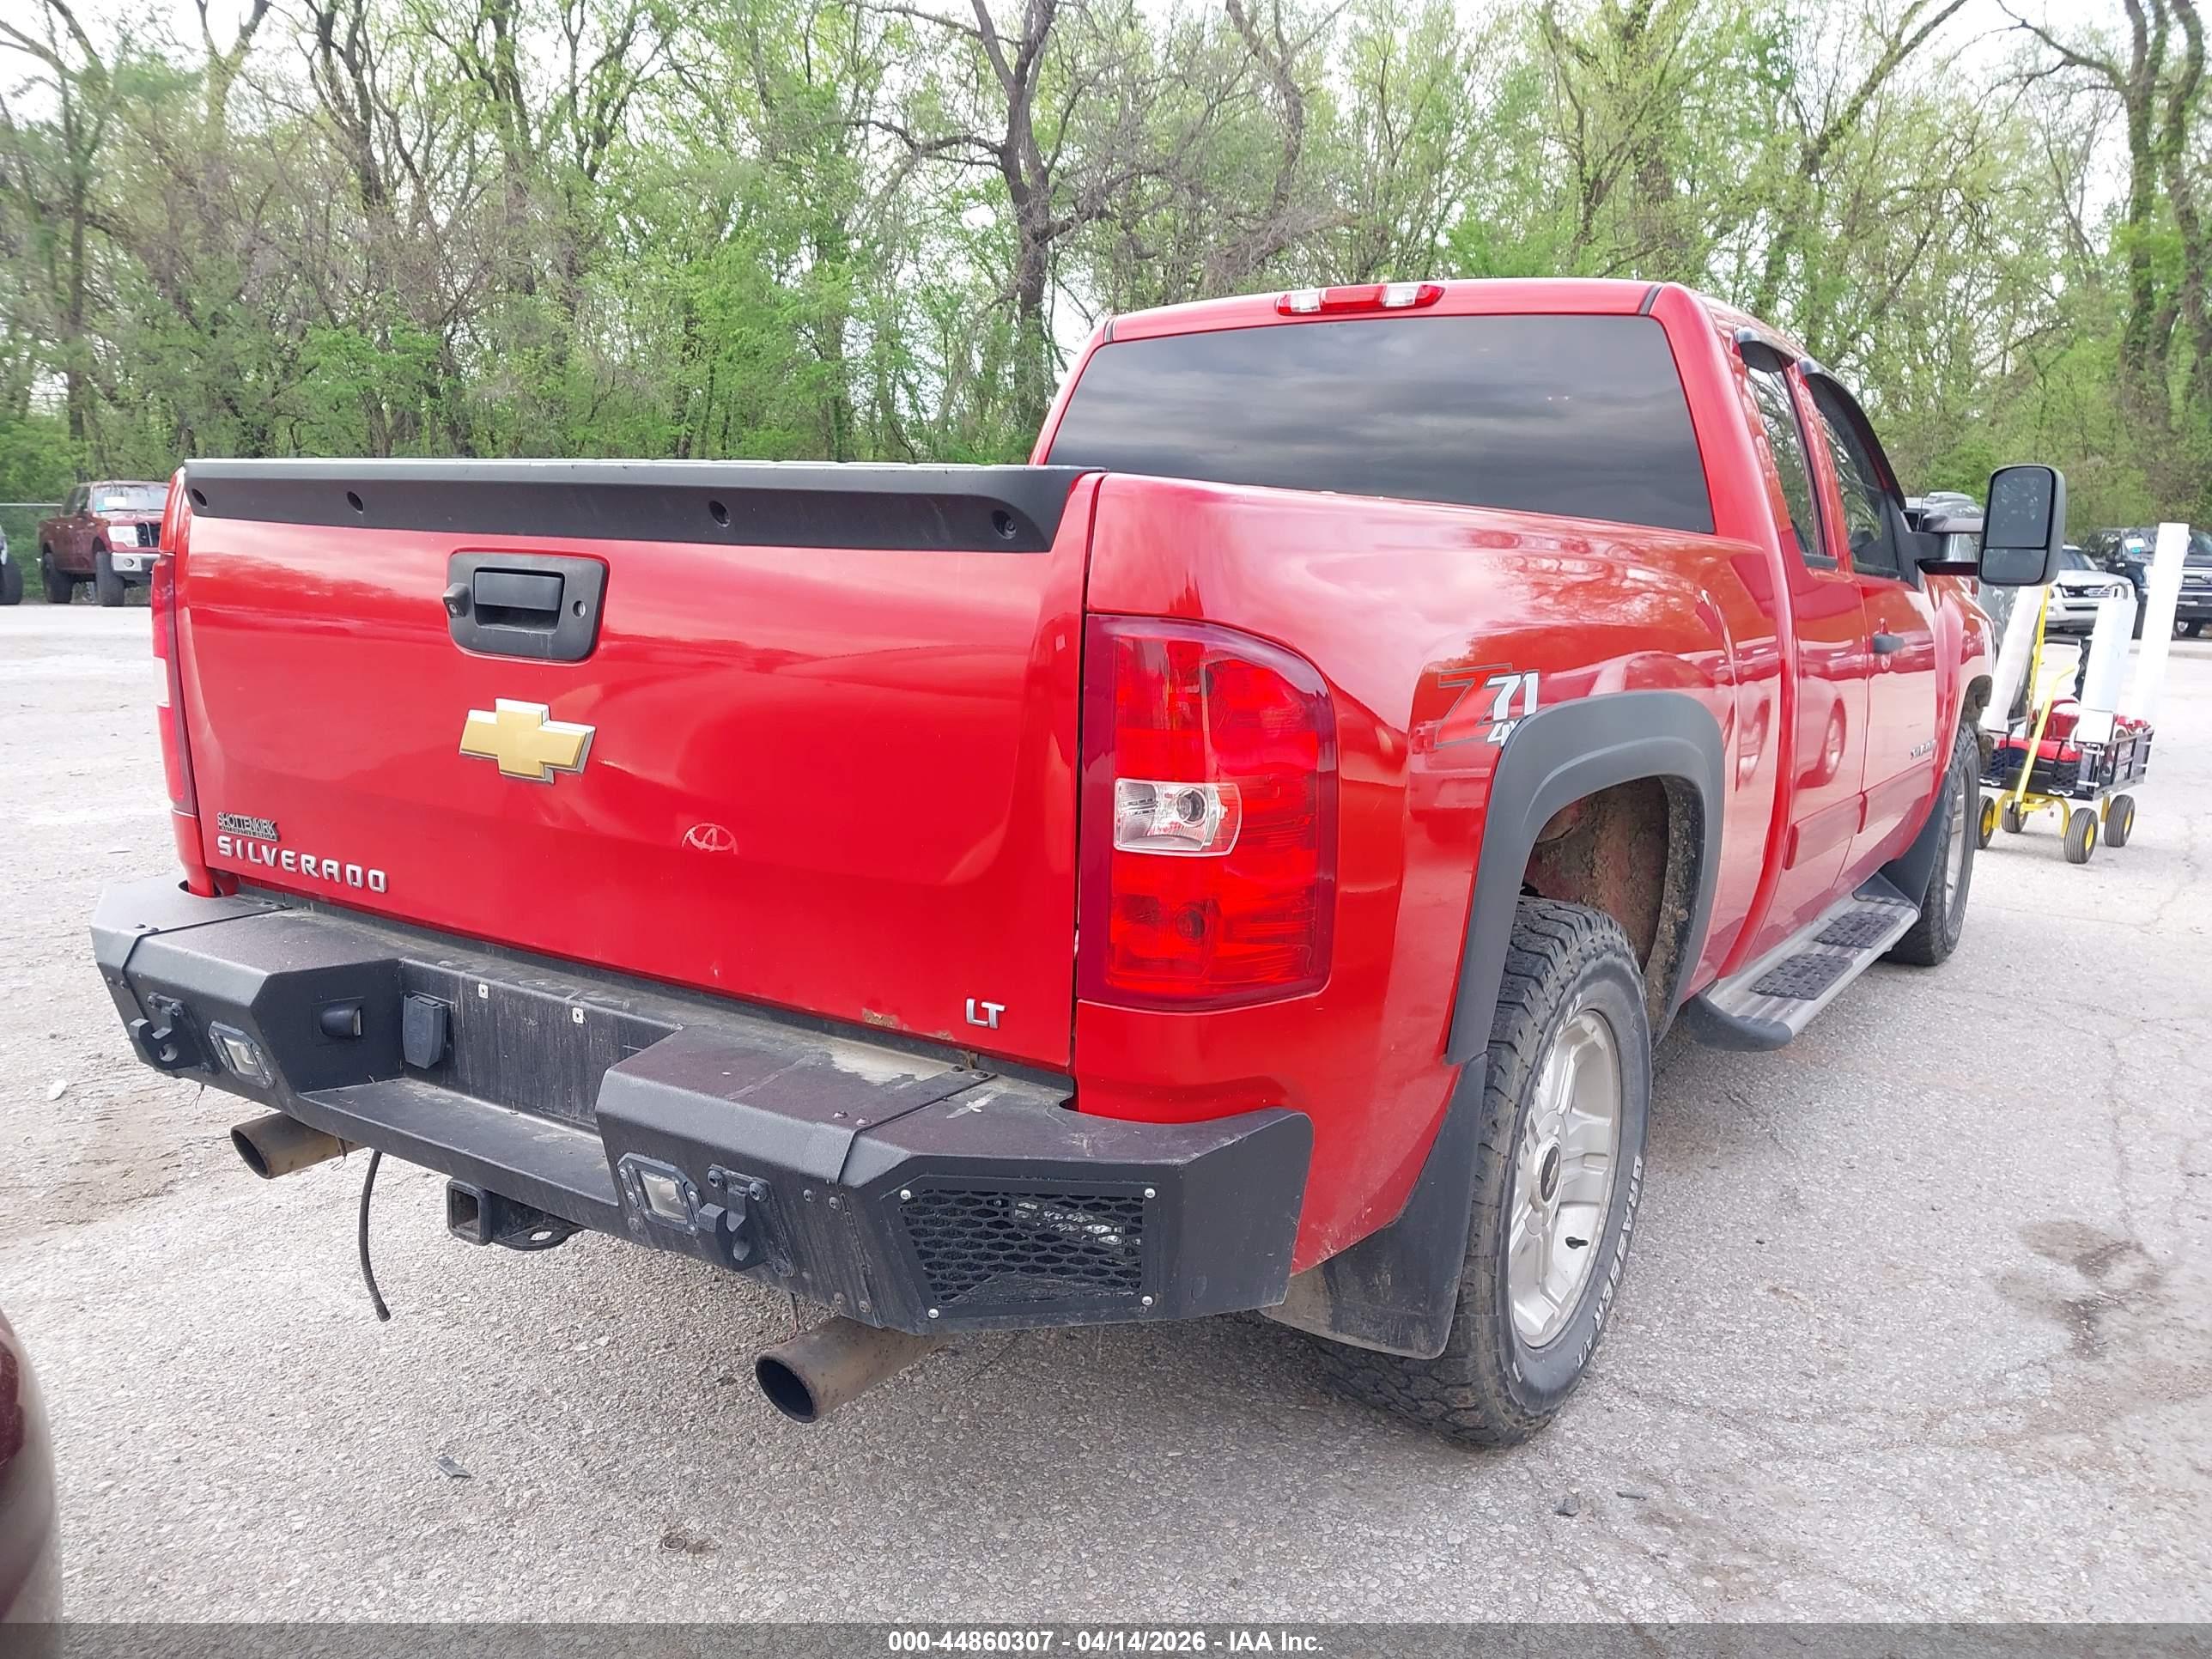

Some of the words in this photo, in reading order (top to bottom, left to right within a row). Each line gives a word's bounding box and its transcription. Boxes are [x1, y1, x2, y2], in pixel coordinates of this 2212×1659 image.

[1435, 663, 1540, 749] Z71
[217, 812, 276, 836] SHOTTENKIRK
[217, 835, 386, 893] SILVERADO
[966, 998, 1006, 1030] LT
[1594, 1155, 1644, 1331] GRABBER
